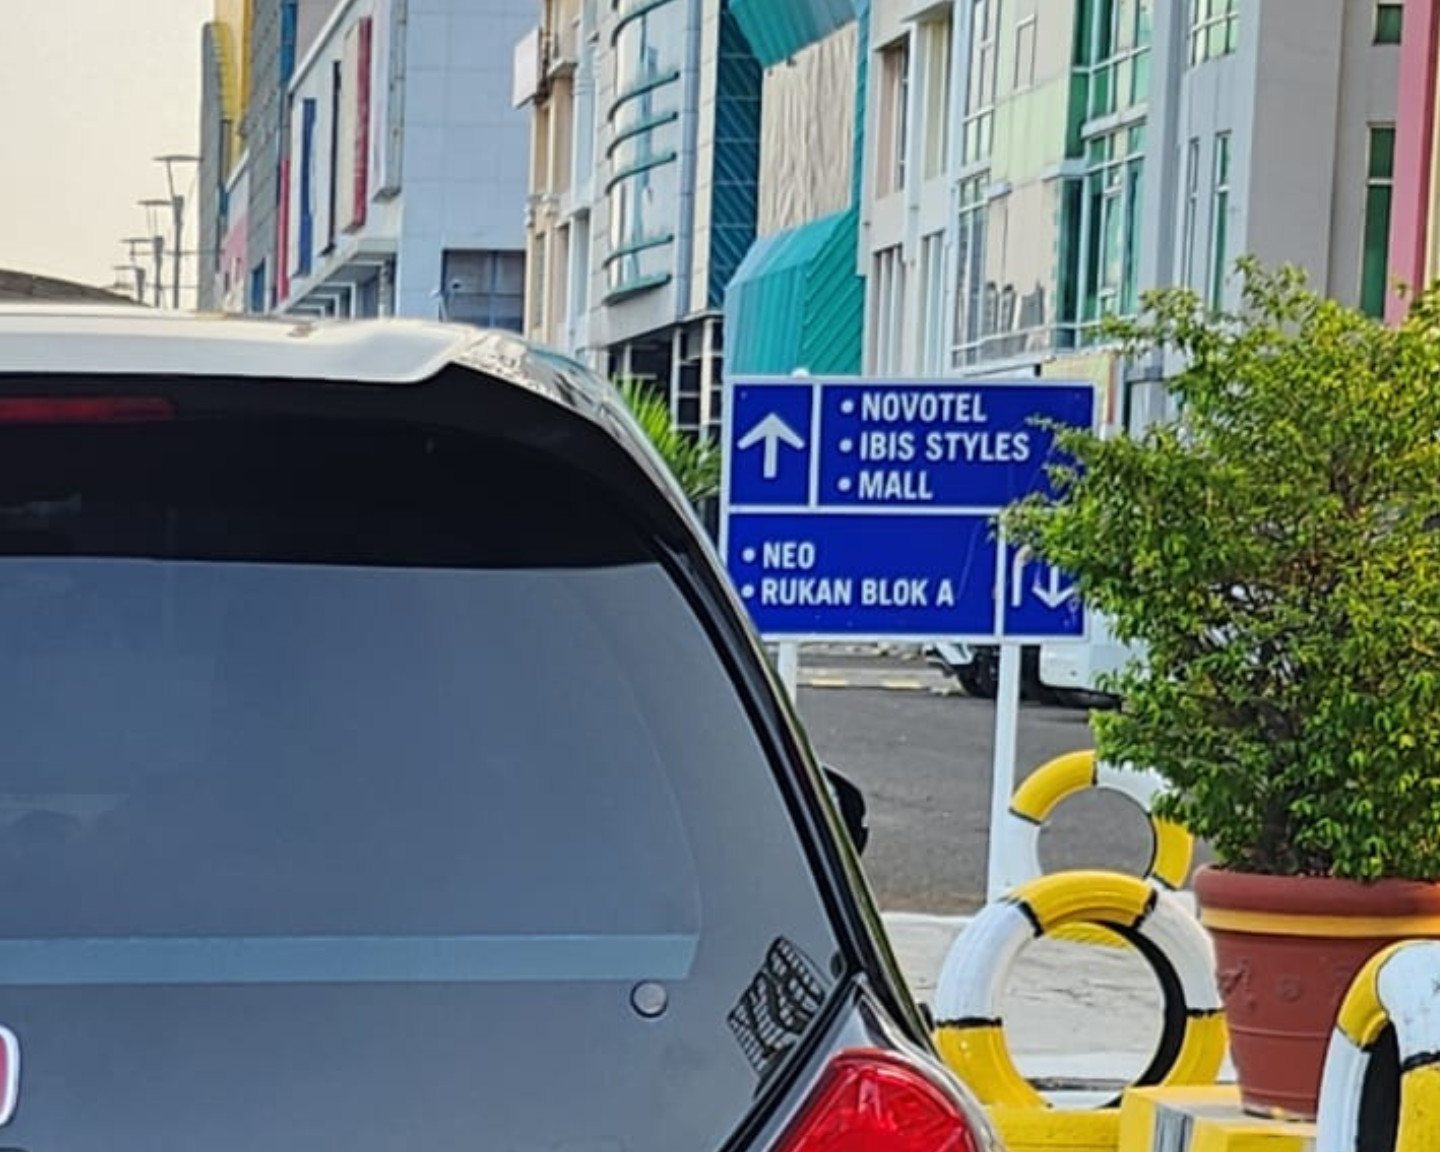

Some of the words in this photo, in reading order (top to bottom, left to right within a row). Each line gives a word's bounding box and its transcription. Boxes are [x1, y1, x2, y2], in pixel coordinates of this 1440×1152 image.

[861, 393, 987, 422] NOVOTEL
[860, 432, 915, 461] IBIS
[926, 433, 1030, 461] STYLES
[858, 471, 933, 499] MALL
[763, 542, 815, 569] NEO
[762, 579, 852, 606] RUKAN
[861, 580, 928, 606] BLOK
[936, 579, 955, 606] A
